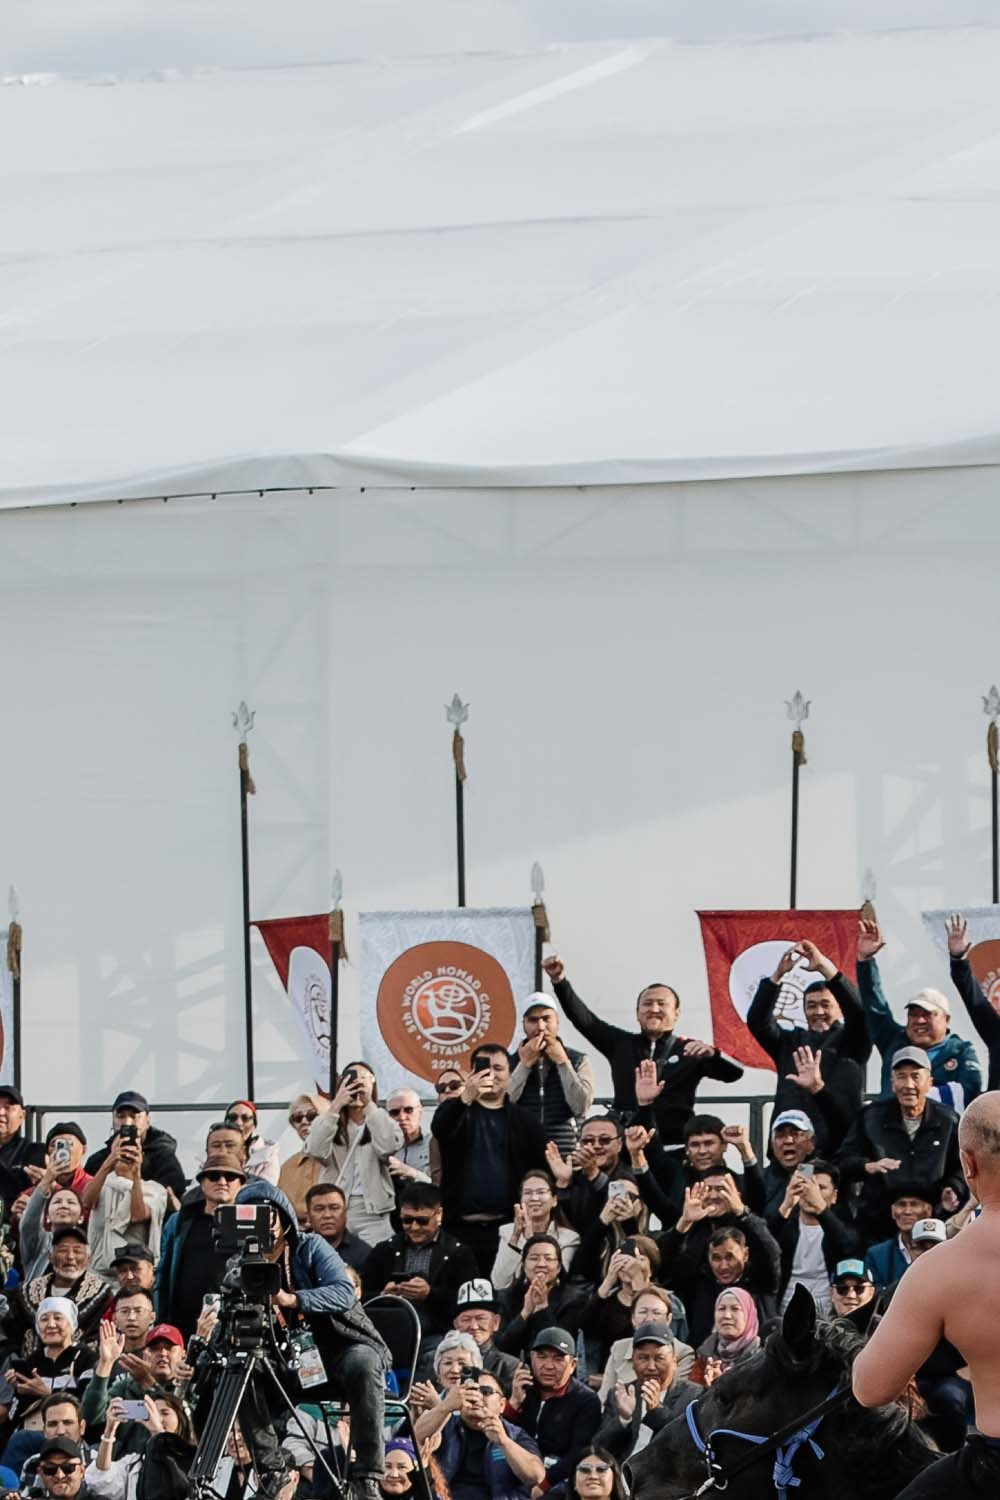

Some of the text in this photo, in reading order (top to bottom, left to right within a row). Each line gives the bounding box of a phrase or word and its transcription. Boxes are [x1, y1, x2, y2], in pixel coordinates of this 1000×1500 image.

[402, 970, 433, 1006] WORLD
[437, 966, 481, 990] NOMAD
[479, 993, 491, 1039] GAMES
[422, 1041, 470, 1055] ASTANA
